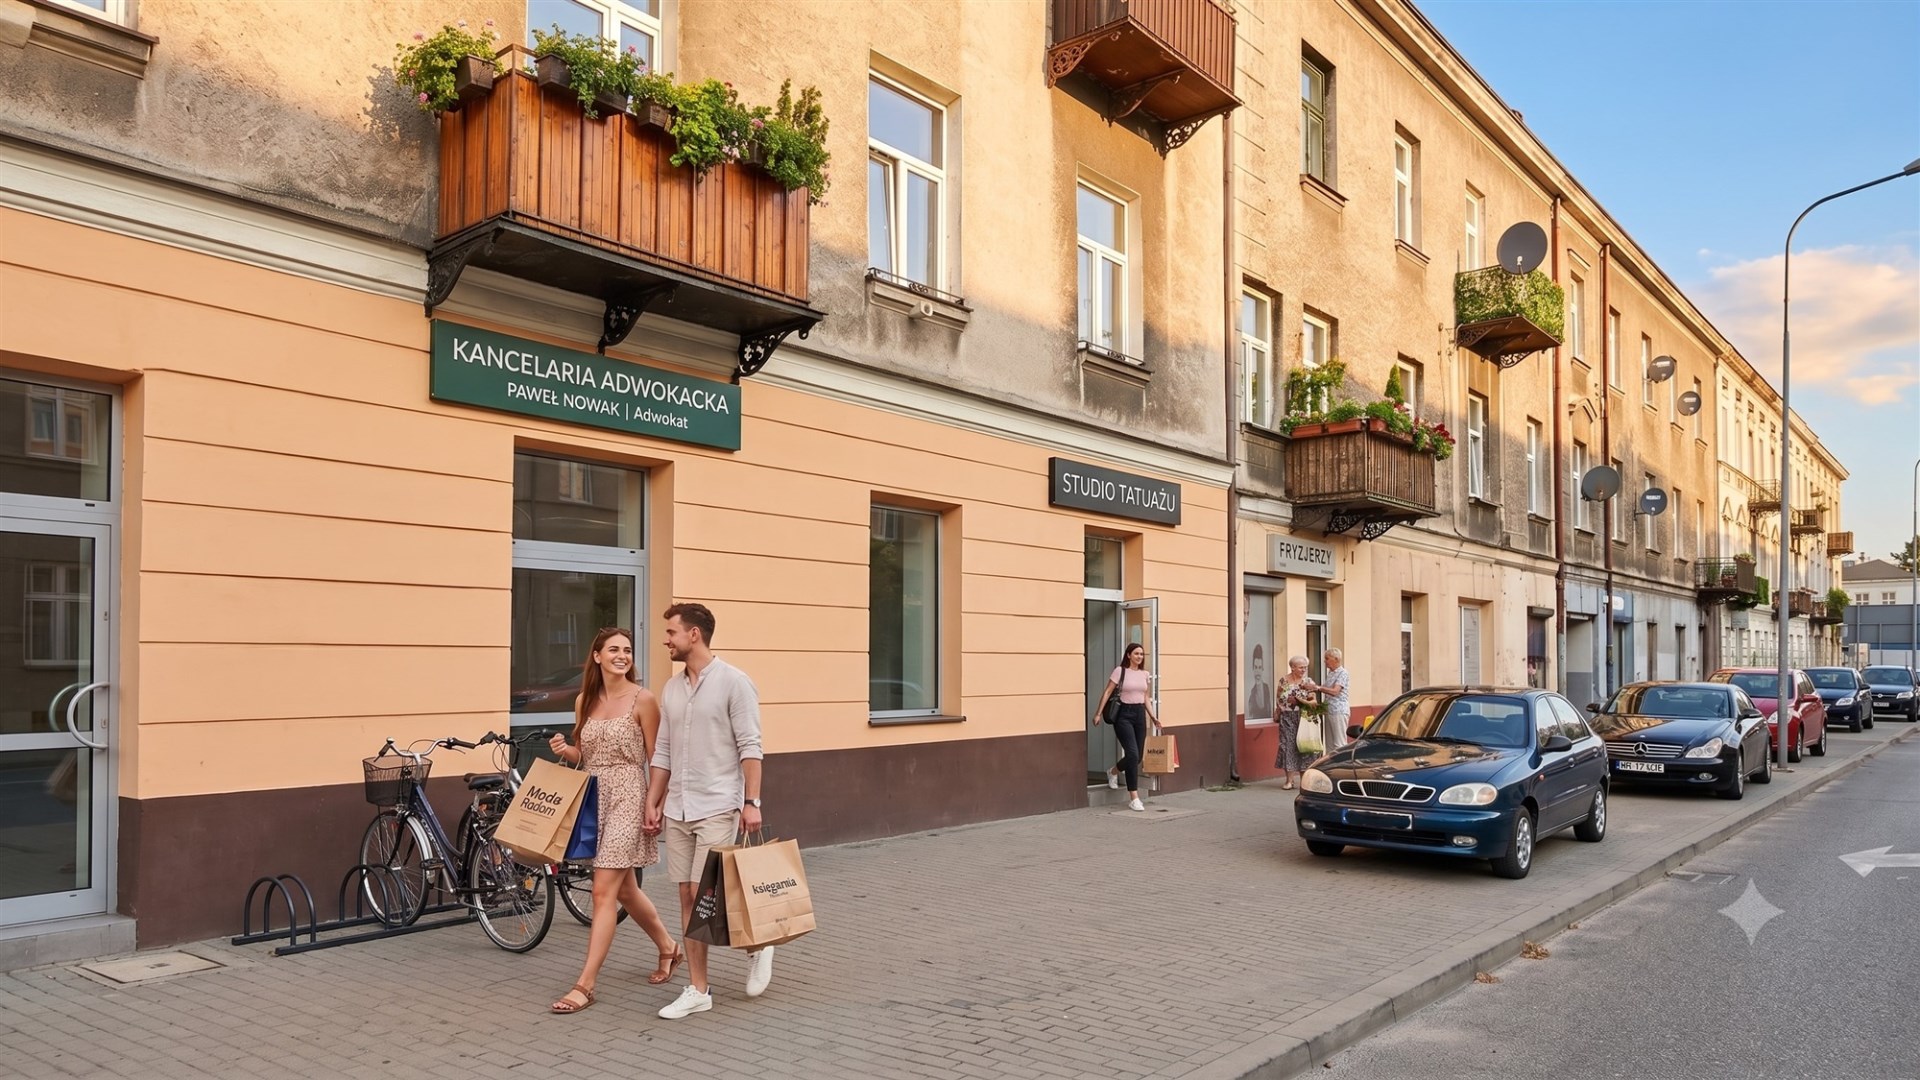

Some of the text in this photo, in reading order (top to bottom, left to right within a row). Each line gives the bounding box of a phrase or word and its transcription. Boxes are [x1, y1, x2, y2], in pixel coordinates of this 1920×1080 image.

[452, 337, 730, 415] KANCELARIA ADWOKACKA
[507, 382, 560, 406] PAWEŁ
[563, 394, 620, 418] NOWAK
[633, 406, 689, 430] Adwokat
[1062, 472, 1176, 513] STUDIO TATUAŻU
[1279, 541, 1332, 565] FRYZJERZY
[520, 797, 556, 817] Radom
[751, 877, 797, 894] księgarnia
